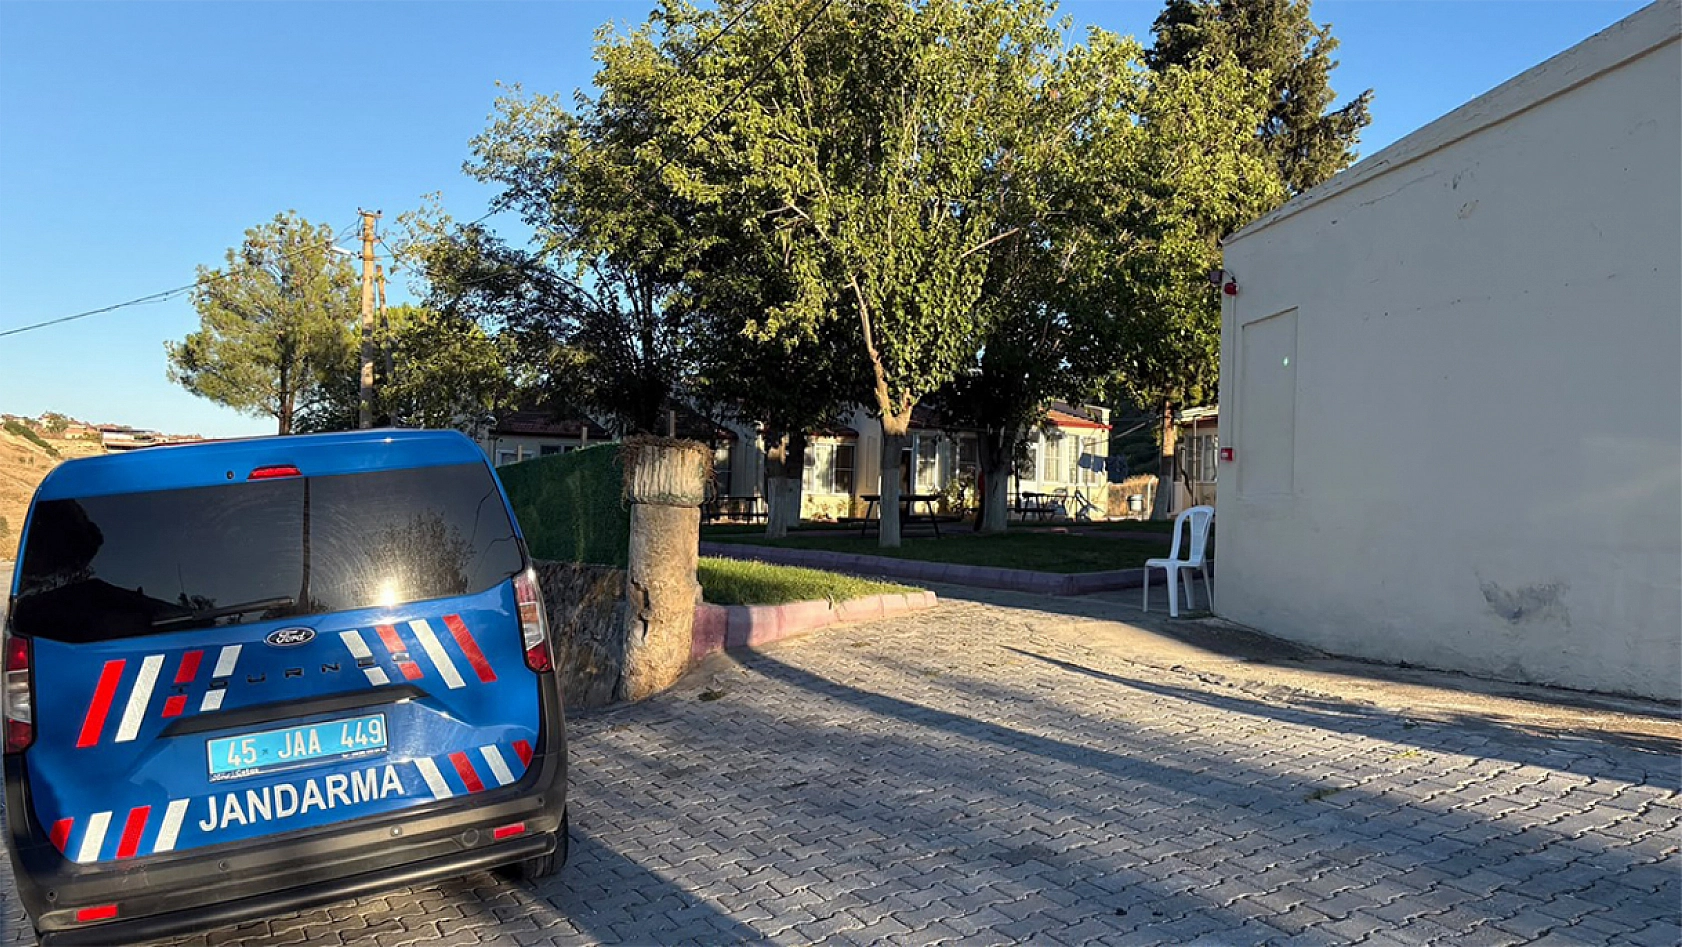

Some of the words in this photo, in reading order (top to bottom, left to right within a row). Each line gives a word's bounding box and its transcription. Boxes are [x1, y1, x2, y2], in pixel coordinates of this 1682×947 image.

[276, 630, 305, 644] Ford
[227, 738, 258, 767] 45
[278, 729, 322, 759] JAA
[340, 719, 382, 749] 449
[199, 765, 405, 832] JANDARMA
